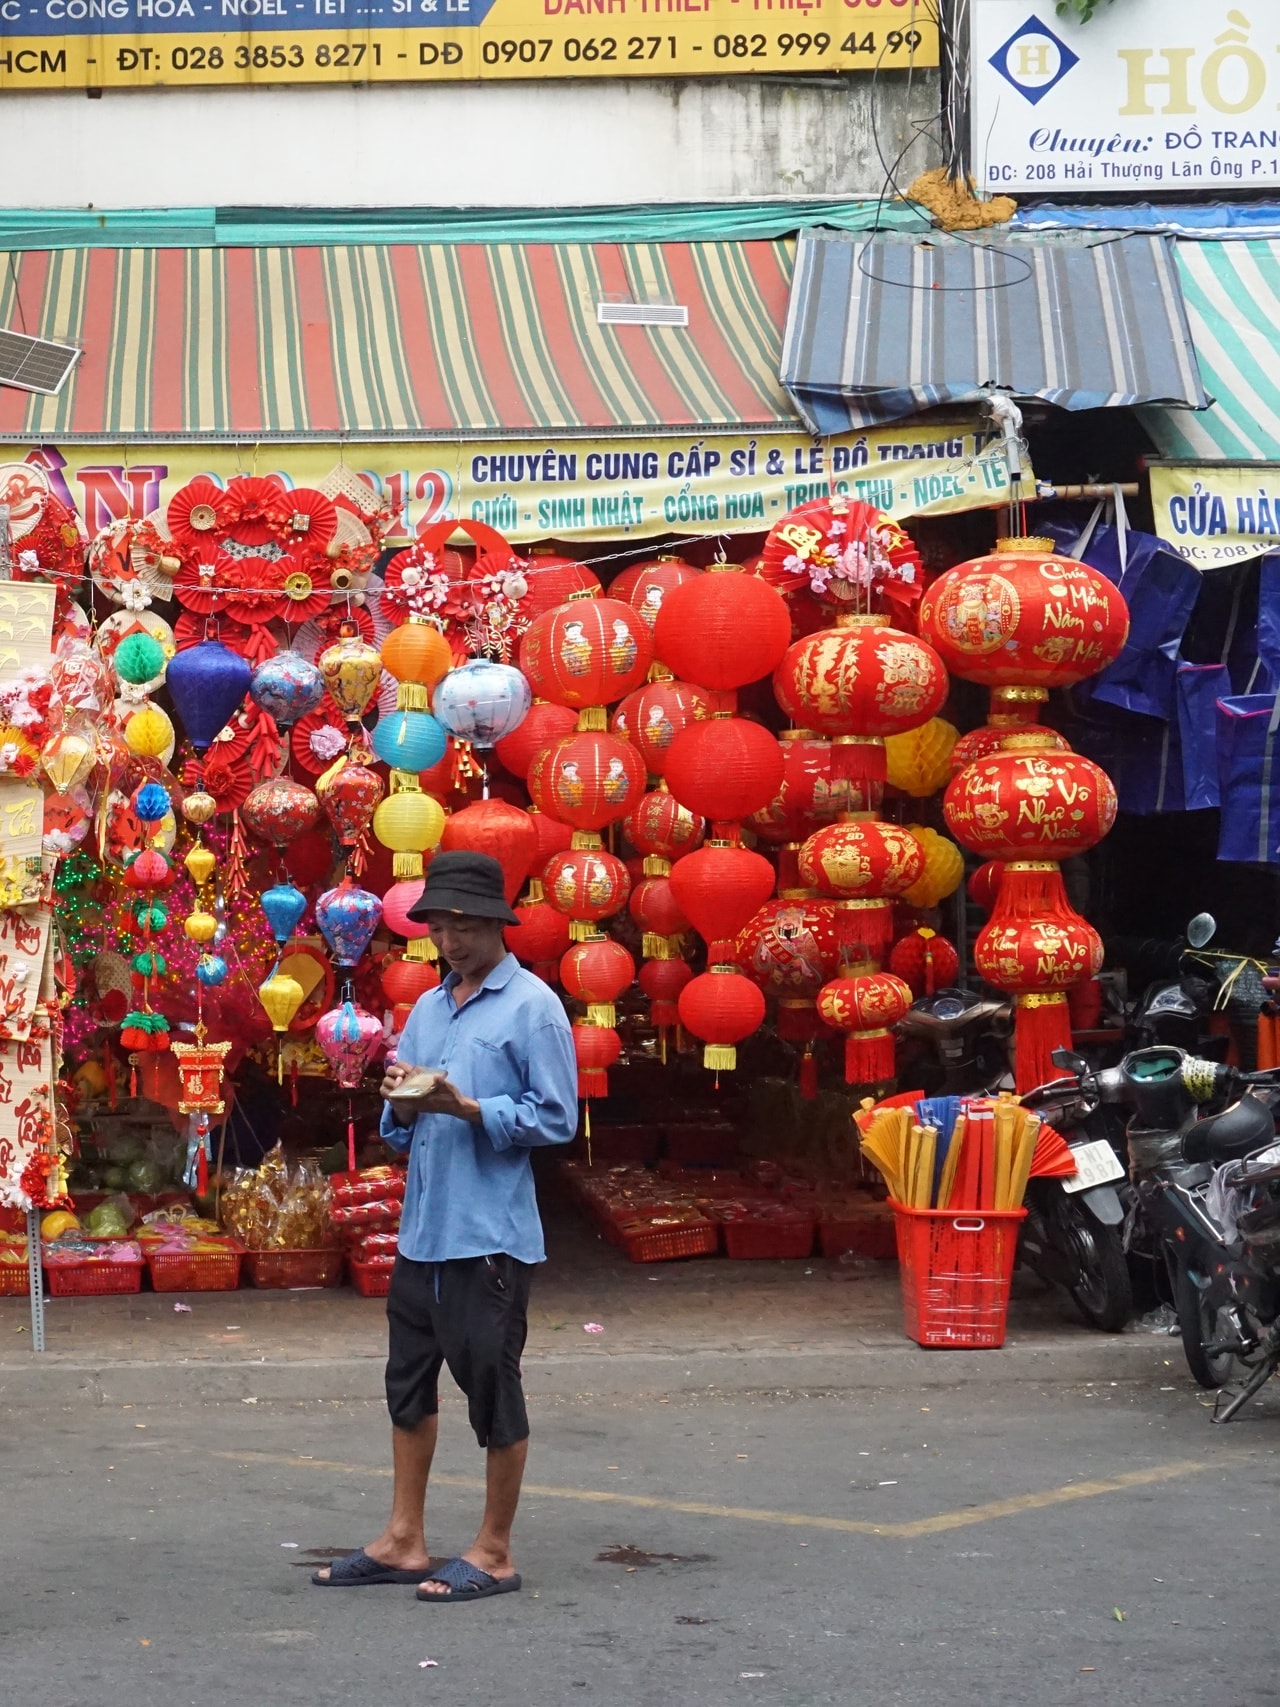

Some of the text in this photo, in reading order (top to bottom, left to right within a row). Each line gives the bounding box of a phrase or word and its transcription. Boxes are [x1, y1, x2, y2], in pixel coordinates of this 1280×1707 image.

[116, 48, 161, 72] ĐT:
[171, 46, 225, 71] 028
[233, 44, 305, 69] 3853
[315, 43, 383, 67] 8271
[419, 41, 464, 65] DĐ
[482, 39, 554, 64] 0907
[563, 37, 618, 62] 062
[627, 35, 678, 60] 271
[713, 33, 768, 58] 082
[777, 32, 831, 56] 999
[840, 31, 876, 55] 44
[886, 29, 922, 54] 99
[1116, 9, 1280, 117] HỒ
[1028, 123, 1280, 158] Chuyên: ĐỒ TRAN
[989, 165, 1018, 182] ĐC:
[1025, 164, 1056, 180] 208
[1064, 160, 1093, 179] Hải
[1100, 160, 1163, 182] Thượng
[1171, 160, 1203, 177] Lãn
[1210, 156, 1243, 179] Ông
[472, 447, 578, 483] CHUYÊN
[585, 452, 658, 482] CUNG
[666, 439, 721, 480] CẤP
[729, 440, 761, 476] SỈ
[765, 451, 786, 475] &
[794, 438, 825, 475] LẺ
[537, 498, 587, 528] SINH
[591, 491, 644, 533] NHẬT
[663, 483, 719, 526] CỔNG
[855, 478, 894, 510] THU
[1169, 482, 1228, 536] CỬA
[1039, 561, 1088, 581] Chúc
[1213, 545, 1249, 560] 208
[1042, 602, 1085, 631] Năm
